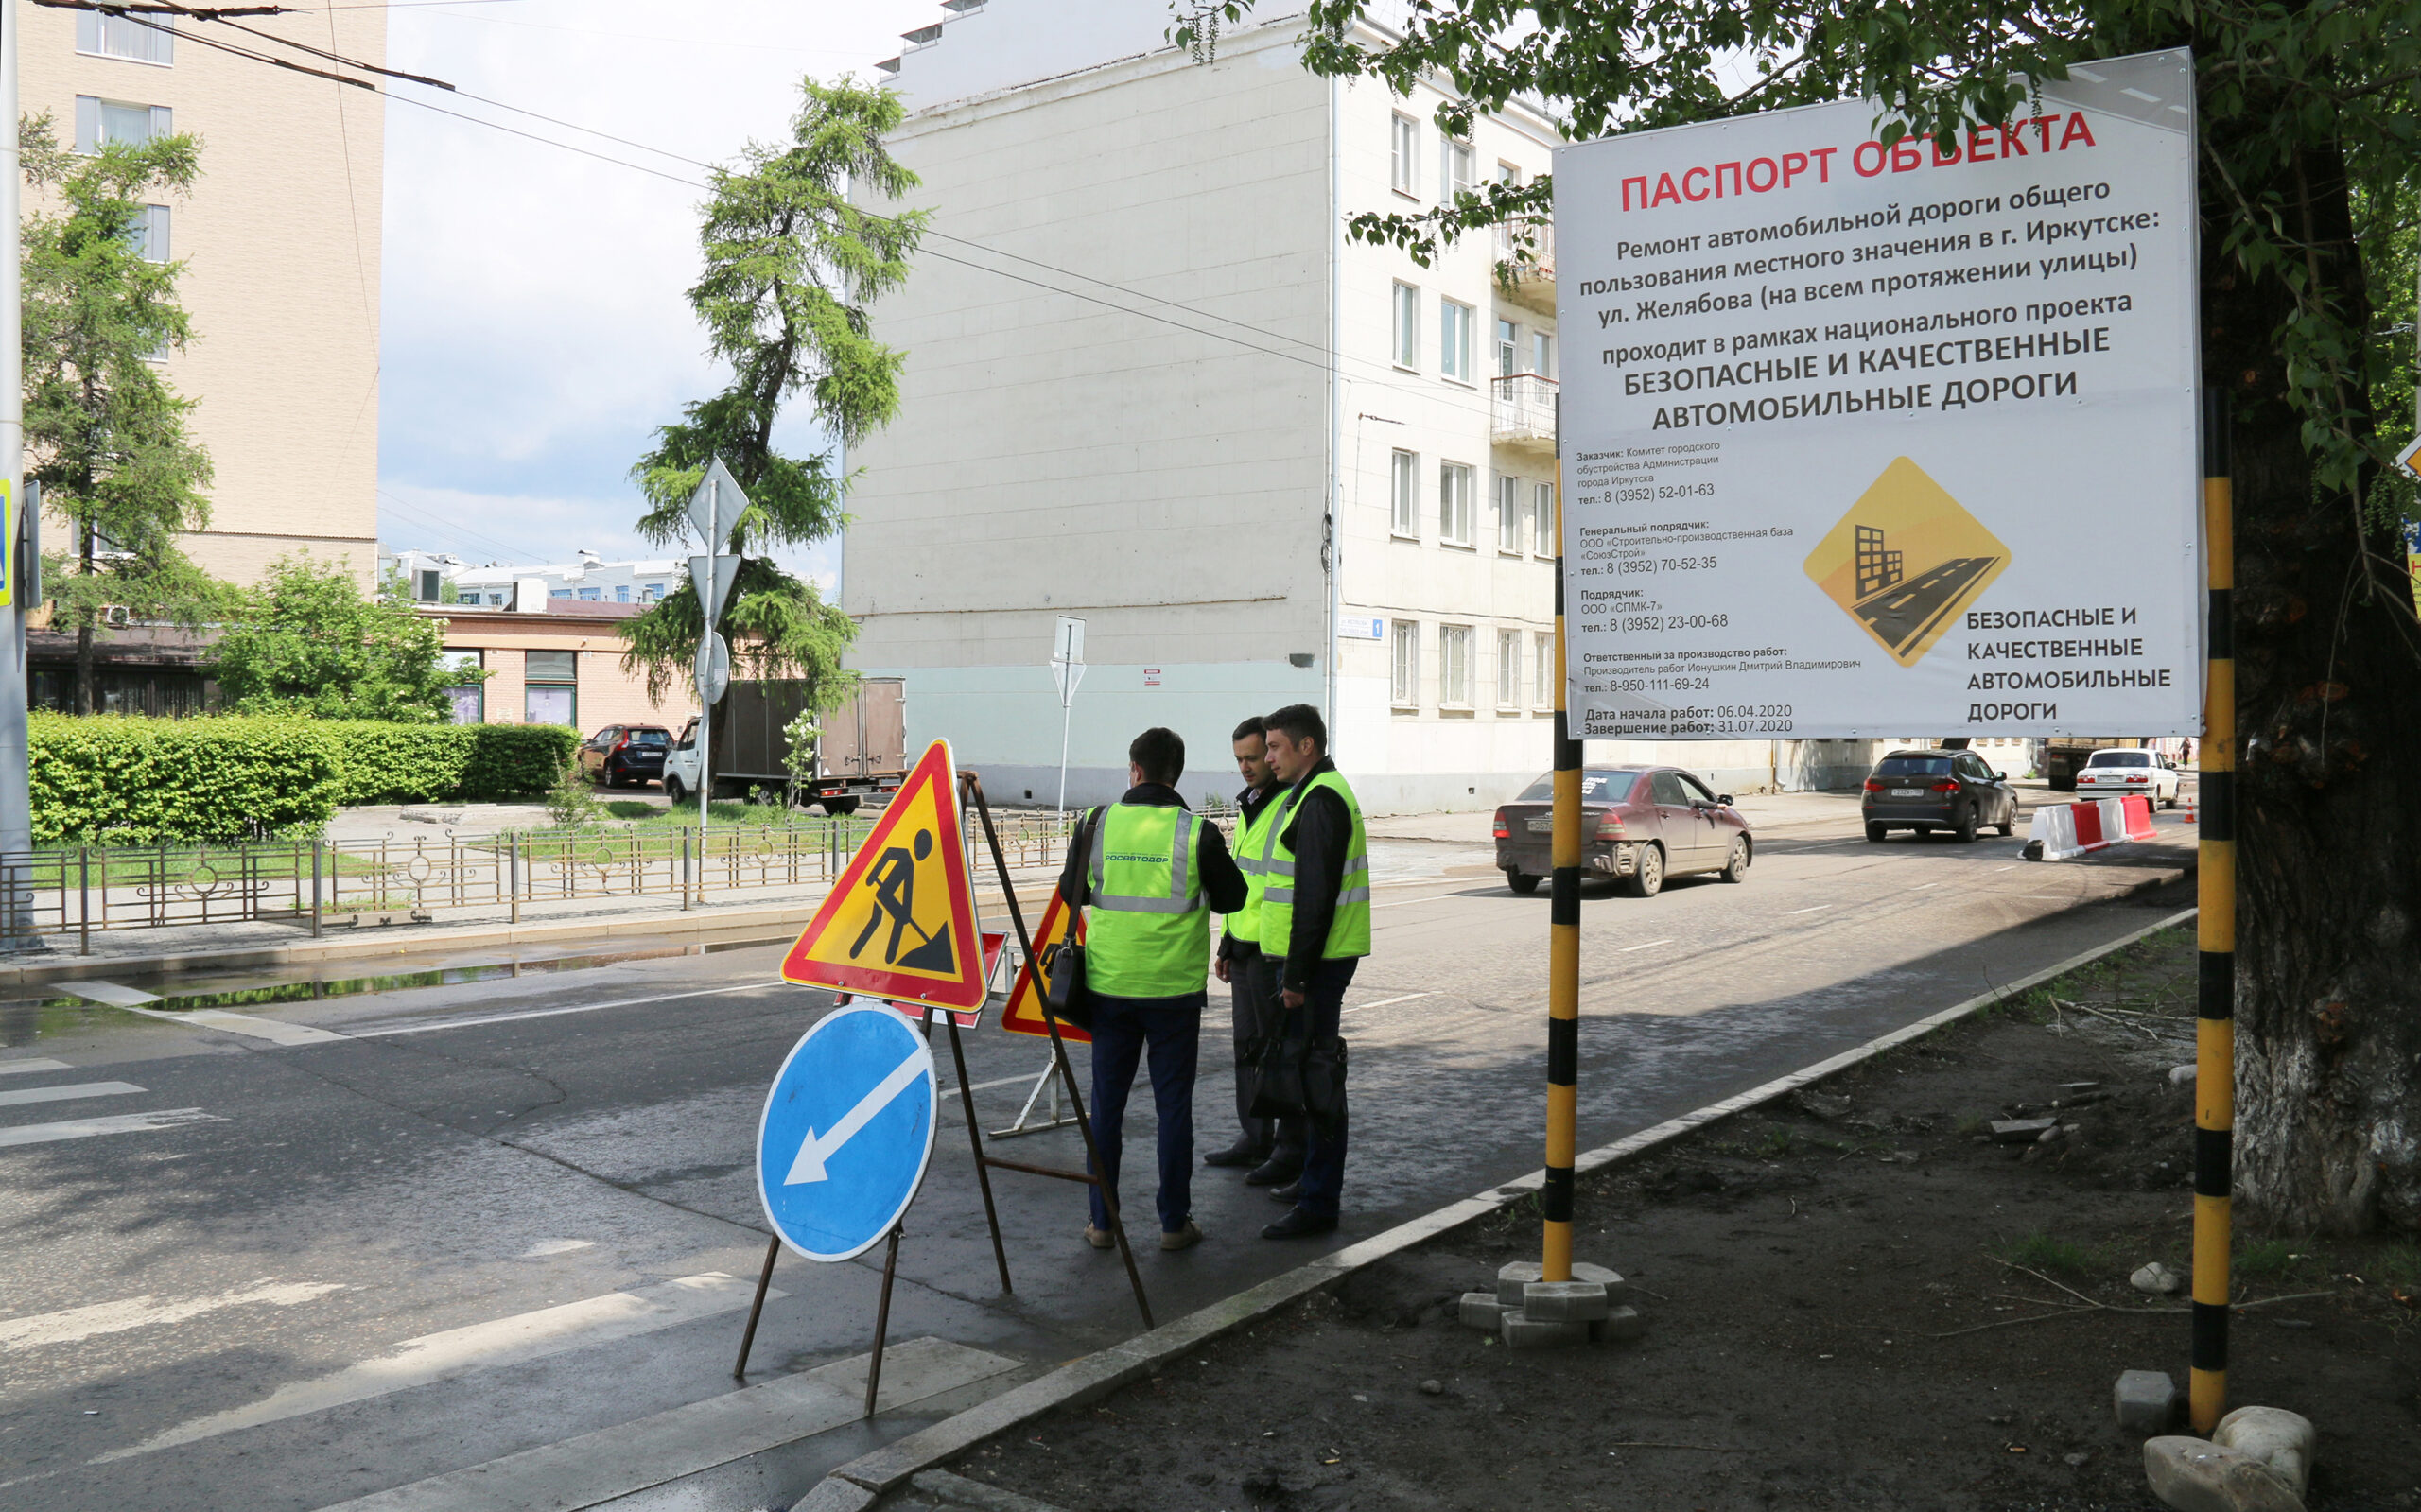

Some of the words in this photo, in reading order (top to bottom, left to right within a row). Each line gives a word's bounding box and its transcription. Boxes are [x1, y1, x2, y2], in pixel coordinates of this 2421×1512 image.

[1622, 147, 1838, 212] ПАСПОРТ
[1618, 236, 1700, 260] Ремонт
[1708, 203, 1900, 248] автомобильной
[1908, 197, 2000, 227] дороги
[2010, 183, 2110, 209] общего
[1580, 265, 1726, 296] пользования
[1734, 251, 1844, 277] местного
[1853, 235, 1970, 262] значения
[1980, 232, 1993, 247] в
[2002, 230, 2016, 245] г.
[2027, 212, 2158, 246] Иркутске:
[1598, 309, 1629, 329] ул.
[1637, 292, 1752, 320] Желябова
[1761, 286, 1796, 310] (на
[1805, 281, 1863, 301] всем
[1872, 262, 2030, 296] протяжении
[2039, 243, 2136, 280] улицы)
[1603, 339, 1706, 368] проходит
[1714, 338, 1725, 353] в
[1733, 327, 1817, 356] рамках
[1825, 307, 2017, 341] национального
[2027, 295, 2131, 328] проекта
[1625, 356, 1818, 395] БЕЗОПАСНЫЕ
[1829, 353, 1847, 376] И
[1859, 327, 2110, 374] КАЧЕСТВЕННЫЕ
[1653, 384, 1931, 430] АВТОМОБИЛЬНЫЕ
[1942, 372, 2076, 410] ДОРОГИ
[1577, 451, 1623, 461] Заказчик:
[1627, 447, 1665, 457] Комитет
[1668, 443, 1720, 455] городского
[1577, 462, 1640, 476] обустройства
[1643, 457, 1718, 470] Администрации
[1578, 478, 1609, 489] города
[1611, 476, 1654, 486] Иркутска
[1578, 495, 1600, 505] тел.:
[1604, 491, 1611, 503] 8
[1616, 488, 1654, 504] (3952)
[1659, 483, 1714, 498] 52-01-63
[1580, 524, 1647, 536] Генеральный
[1650, 521, 1709, 533] подрядчик:
[1580, 538, 1604, 548] ООО
[1607, 530, 1767, 547] «Строительно-производственная
[1770, 528, 1793, 536] база
[1581, 548, 1645, 562] «СоюзСтрой»
[1581, 566, 1603, 576] тел.:
[1607, 563, 1613, 574] 8
[1618, 560, 1657, 576] (3952)
[1662, 556, 1716, 570] 70-52-35
[1581, 590, 1643, 601] Подрядчик:
[1581, 603, 1607, 614] ООО
[1611, 601, 1662, 613] «СПМК-7»
[1581, 624, 1606, 633] тел.:
[1610, 618, 1617, 631] 8
[1622, 617, 1663, 634] (3952)
[1668, 614, 1728, 629] 23-00-68
[1968, 608, 2114, 629] БЕЗОПАСНЫЕ
[2122, 608, 2135, 624] И
[1584, 653, 1661, 662] Ответственный
[1678, 651, 1750, 661] производство
[1753, 647, 1786, 658] работ:
[1968, 638, 2142, 659] КАЧЕСТВЕННЫЕ
[1584, 665, 1655, 676] Производитель
[1658, 664, 1685, 675] работ
[1688, 663, 1736, 673] Ионушкин
[1739, 661, 1782, 672] Дмитрий
[1785, 660, 1860, 670] Владимирович
[1584, 685, 1607, 693] тел.:
[1611, 677, 1709, 692] 8-950-111-69-24
[1967, 669, 2170, 689] АВТОМОБИЛЬНЫЕ
[1585, 709, 1615, 722] Дата
[1620, 710, 1666, 719] начала
[1671, 706, 1713, 721] работ:
[1717, 704, 1792, 718] 06.04.2020
[1968, 703, 2056, 722] ДОРОГИ
[1585, 723, 1666, 738] Завершение
[1670, 721, 1714, 736] работ:
[1718, 720, 1792, 733] 31.07.2020
